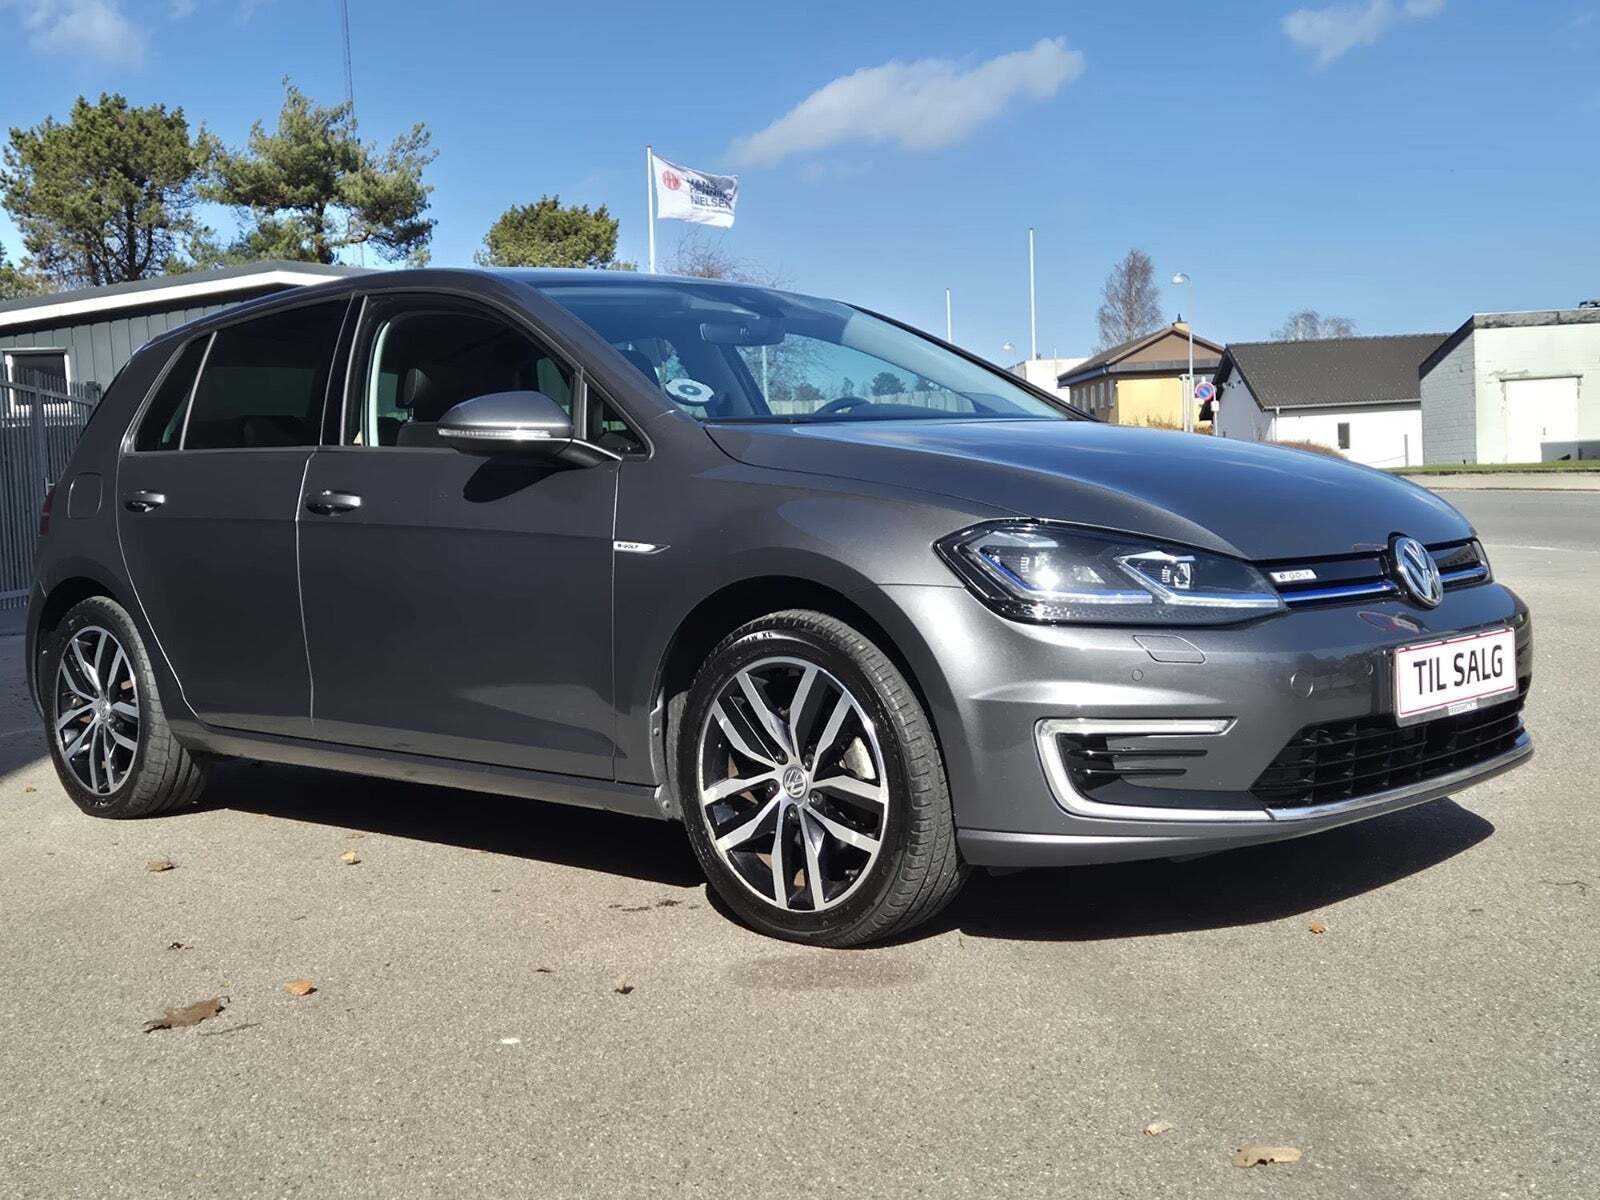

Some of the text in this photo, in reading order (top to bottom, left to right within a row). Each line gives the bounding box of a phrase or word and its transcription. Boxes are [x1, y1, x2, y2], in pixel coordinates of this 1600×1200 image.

[690, 195, 732, 209] NIELSEN
[1413, 645, 1503, 695] TIL SALG
